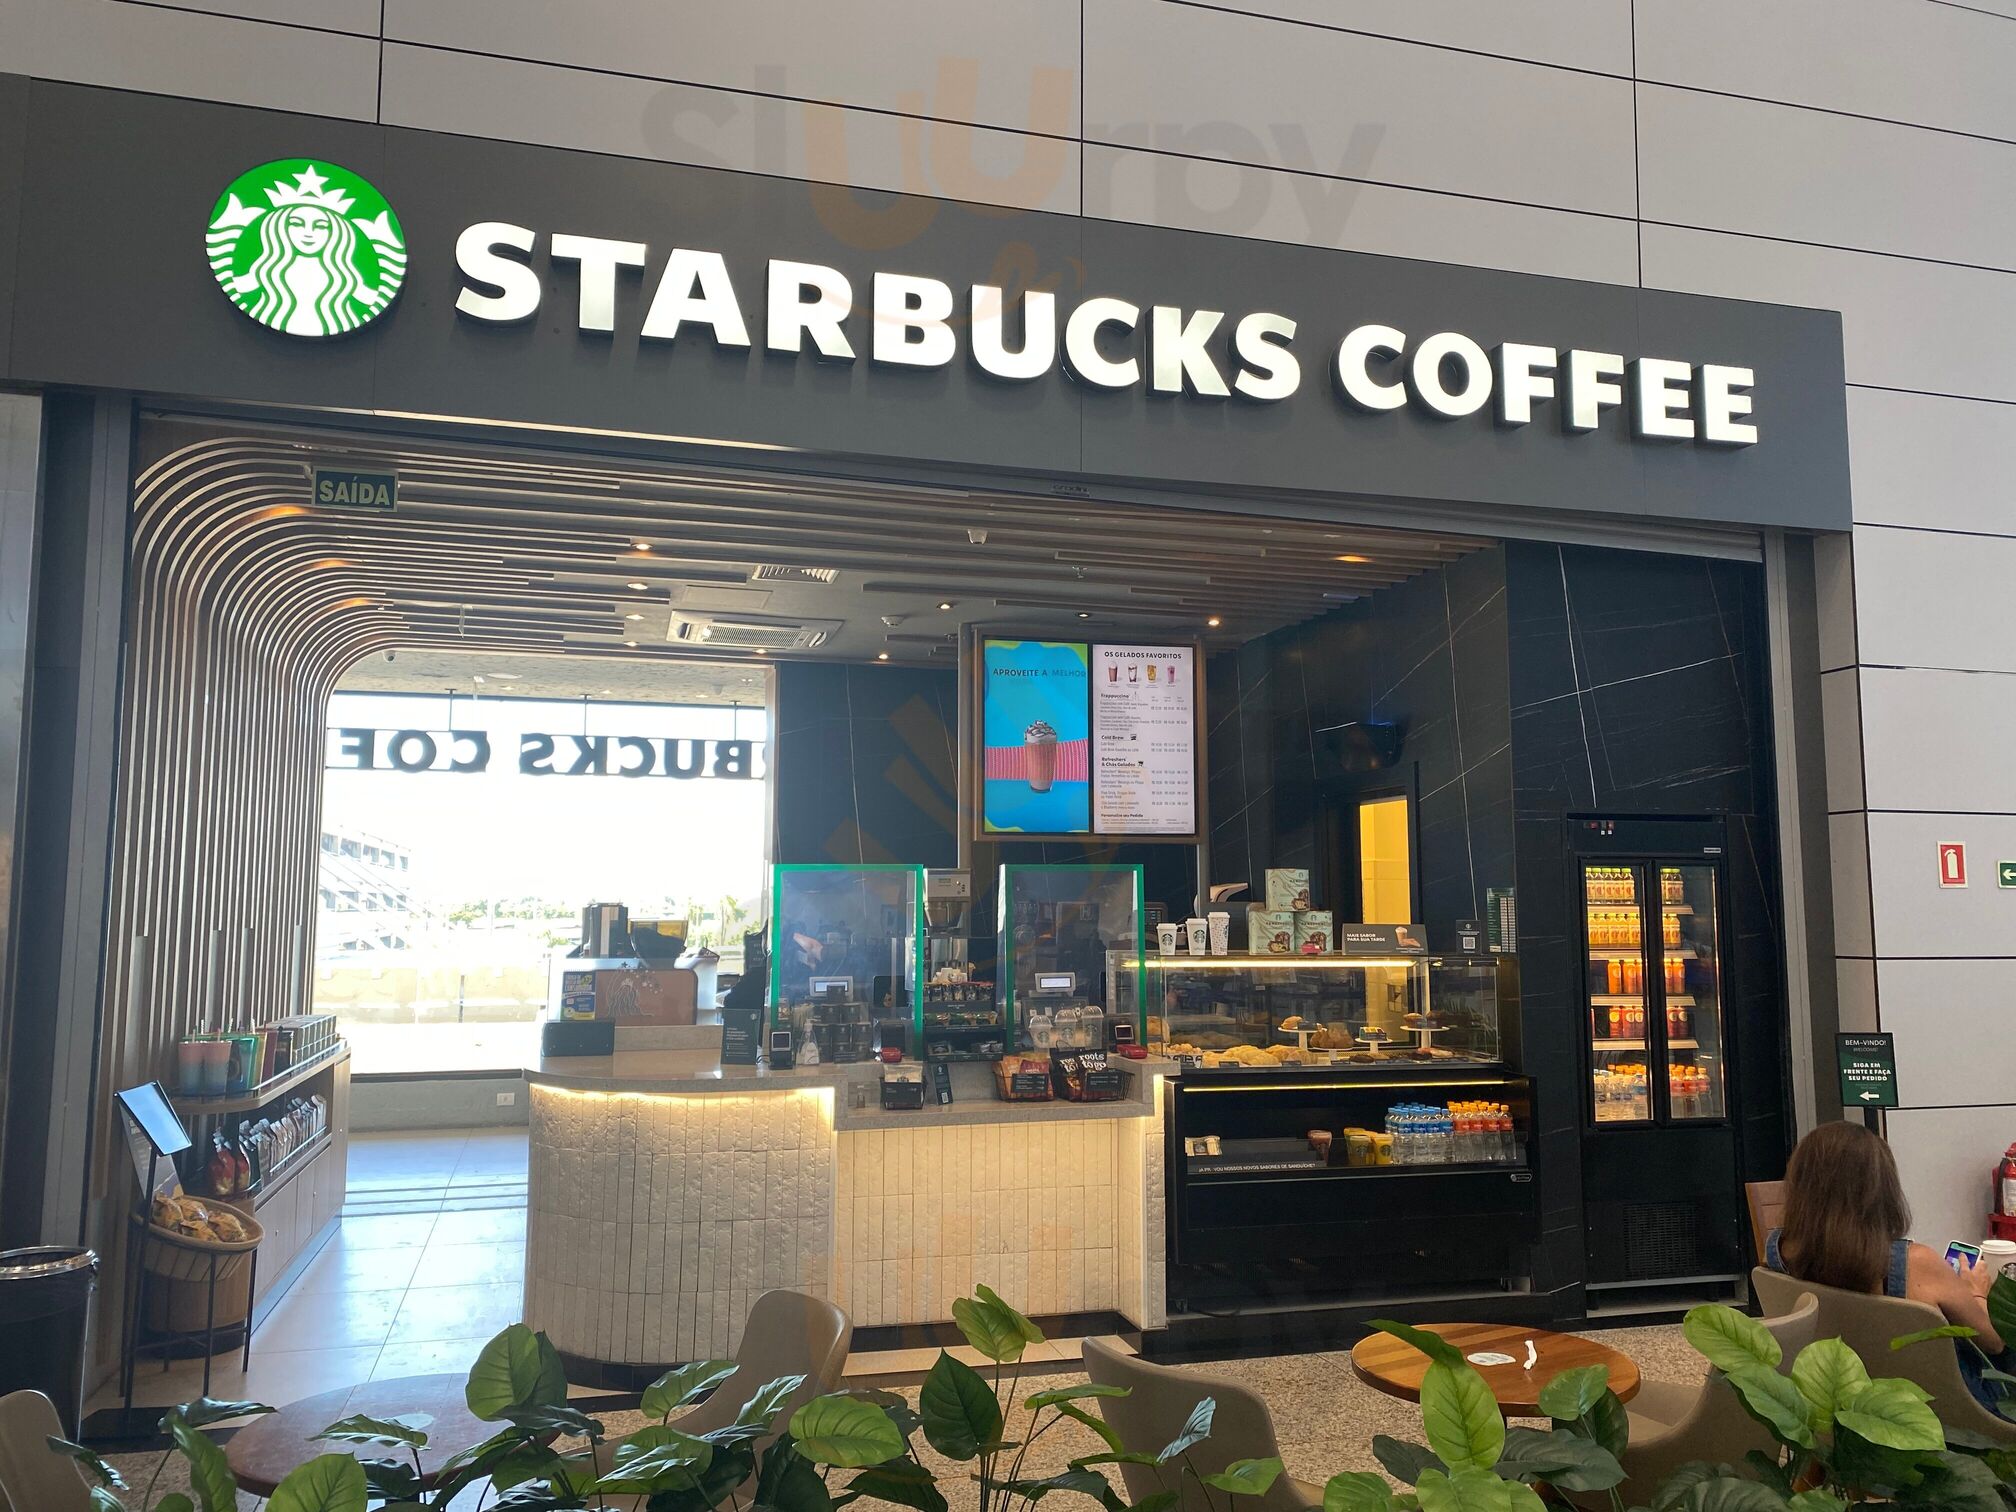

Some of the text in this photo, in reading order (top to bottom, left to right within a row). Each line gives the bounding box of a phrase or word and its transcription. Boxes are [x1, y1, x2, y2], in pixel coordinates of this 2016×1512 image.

[455, 222, 1758, 446] STARBUCKS COFFEE
[319, 476, 391, 506] SAÍDA
[993, 668, 1039, 677] APROVEITE
[1078, 1052, 1105, 1061] roots
[1082, 1060, 1106, 1070] to go
